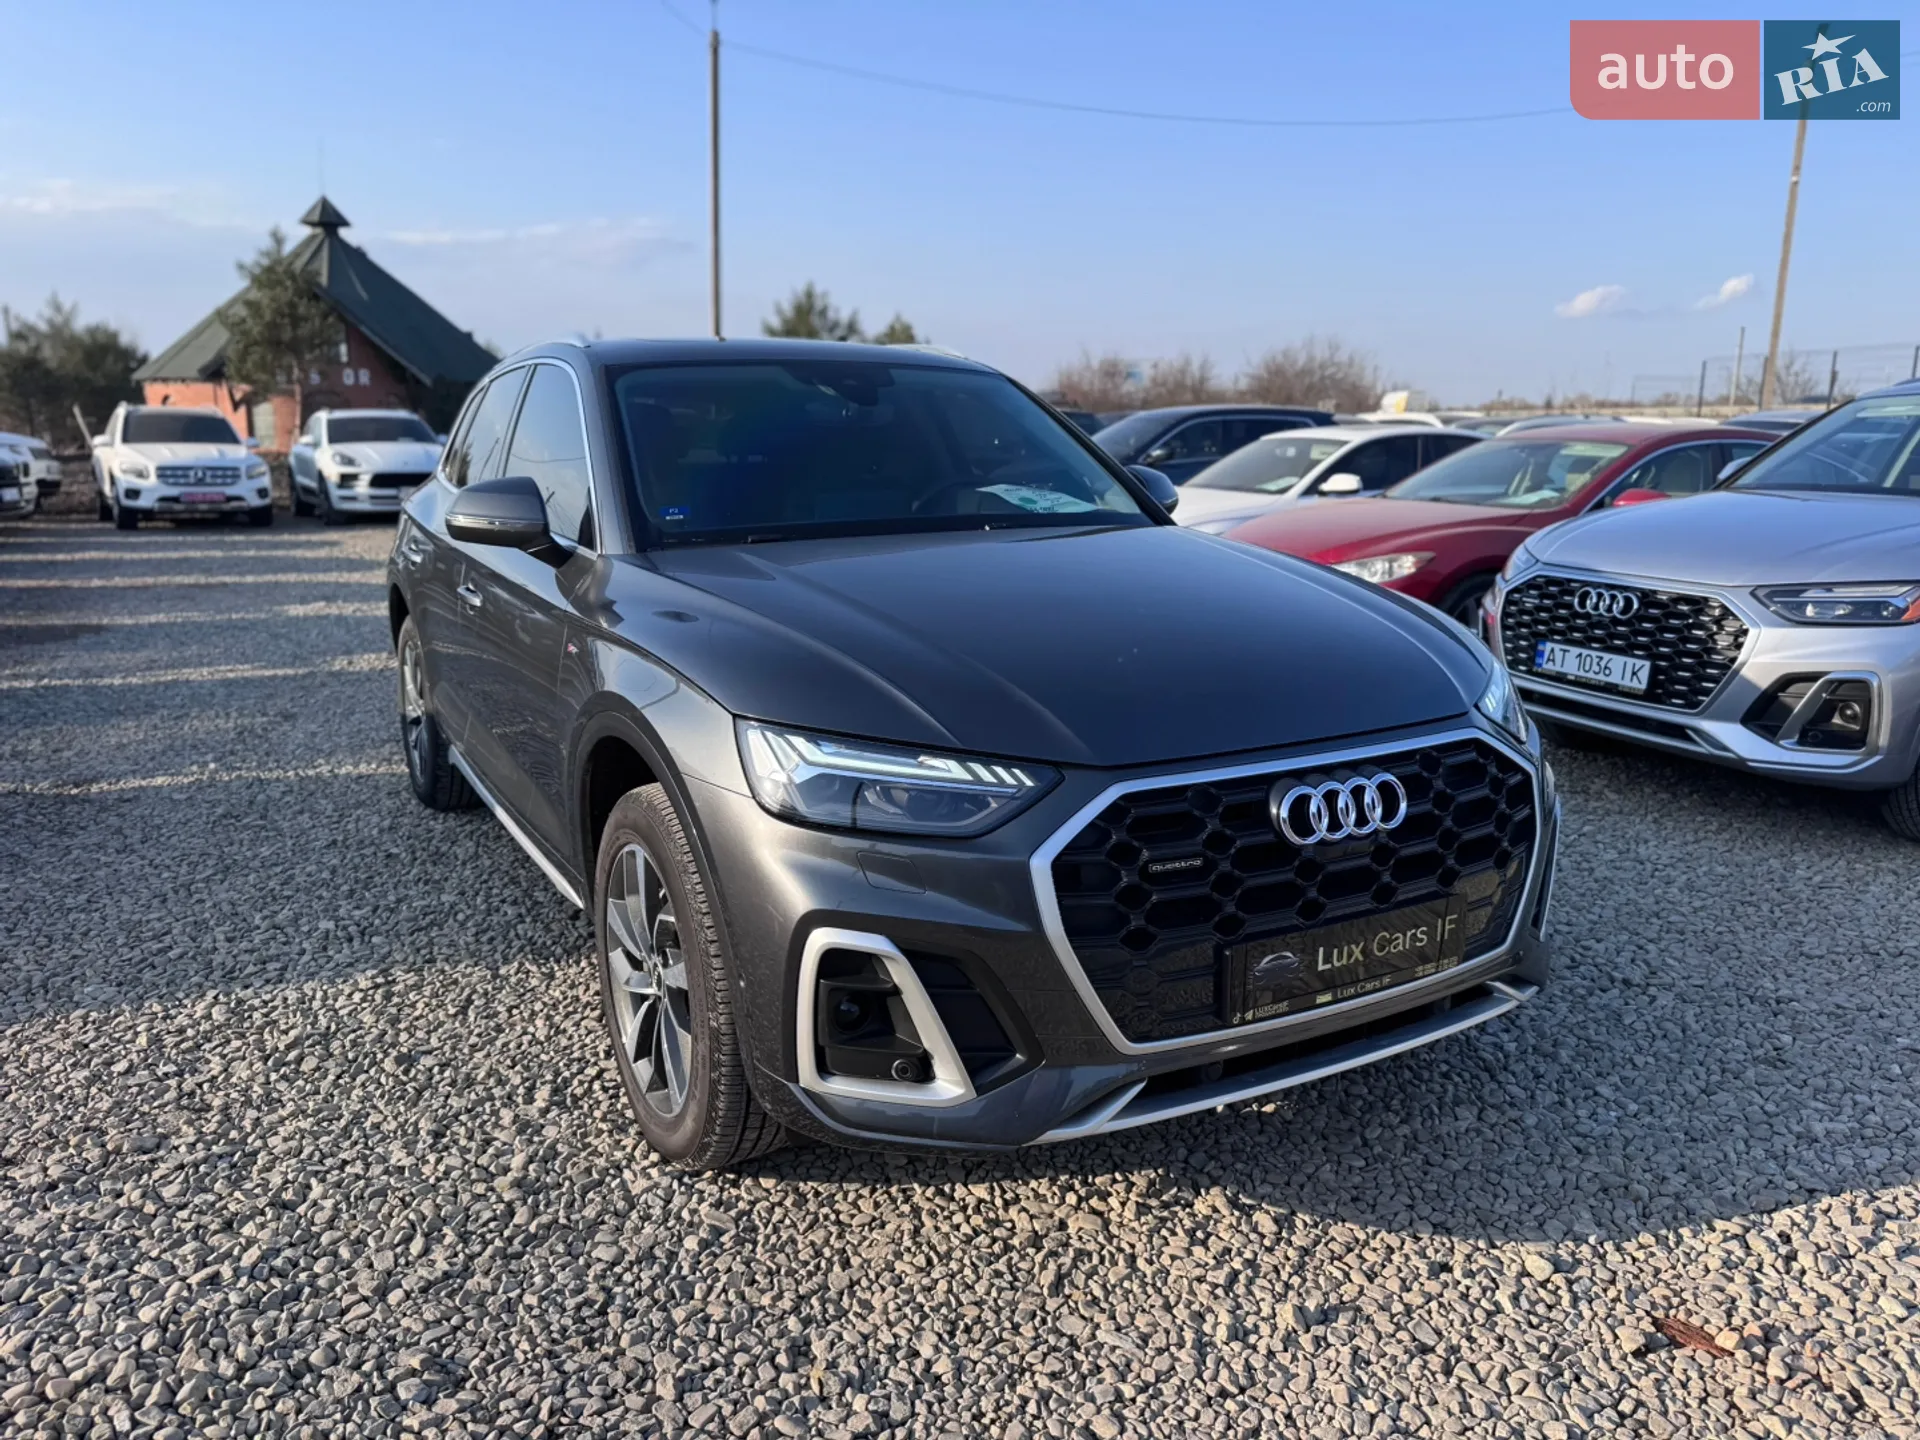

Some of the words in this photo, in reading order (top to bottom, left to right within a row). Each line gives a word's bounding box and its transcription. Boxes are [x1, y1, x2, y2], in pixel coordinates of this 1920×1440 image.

[1545, 647, 1570, 668] AT
[1574, 652, 1613, 677] 1036
[1621, 660, 1647, 685] IK
[1152, 860, 1201, 872] quattro
[1316, 938, 1365, 972] Lux
[1372, 923, 1428, 957] Cars
[1436, 914, 1458, 942] IF
[1337, 987, 1356, 999] Lux
[1357, 979, 1381, 993] Cars
[1382, 974, 1392, 987] IF
